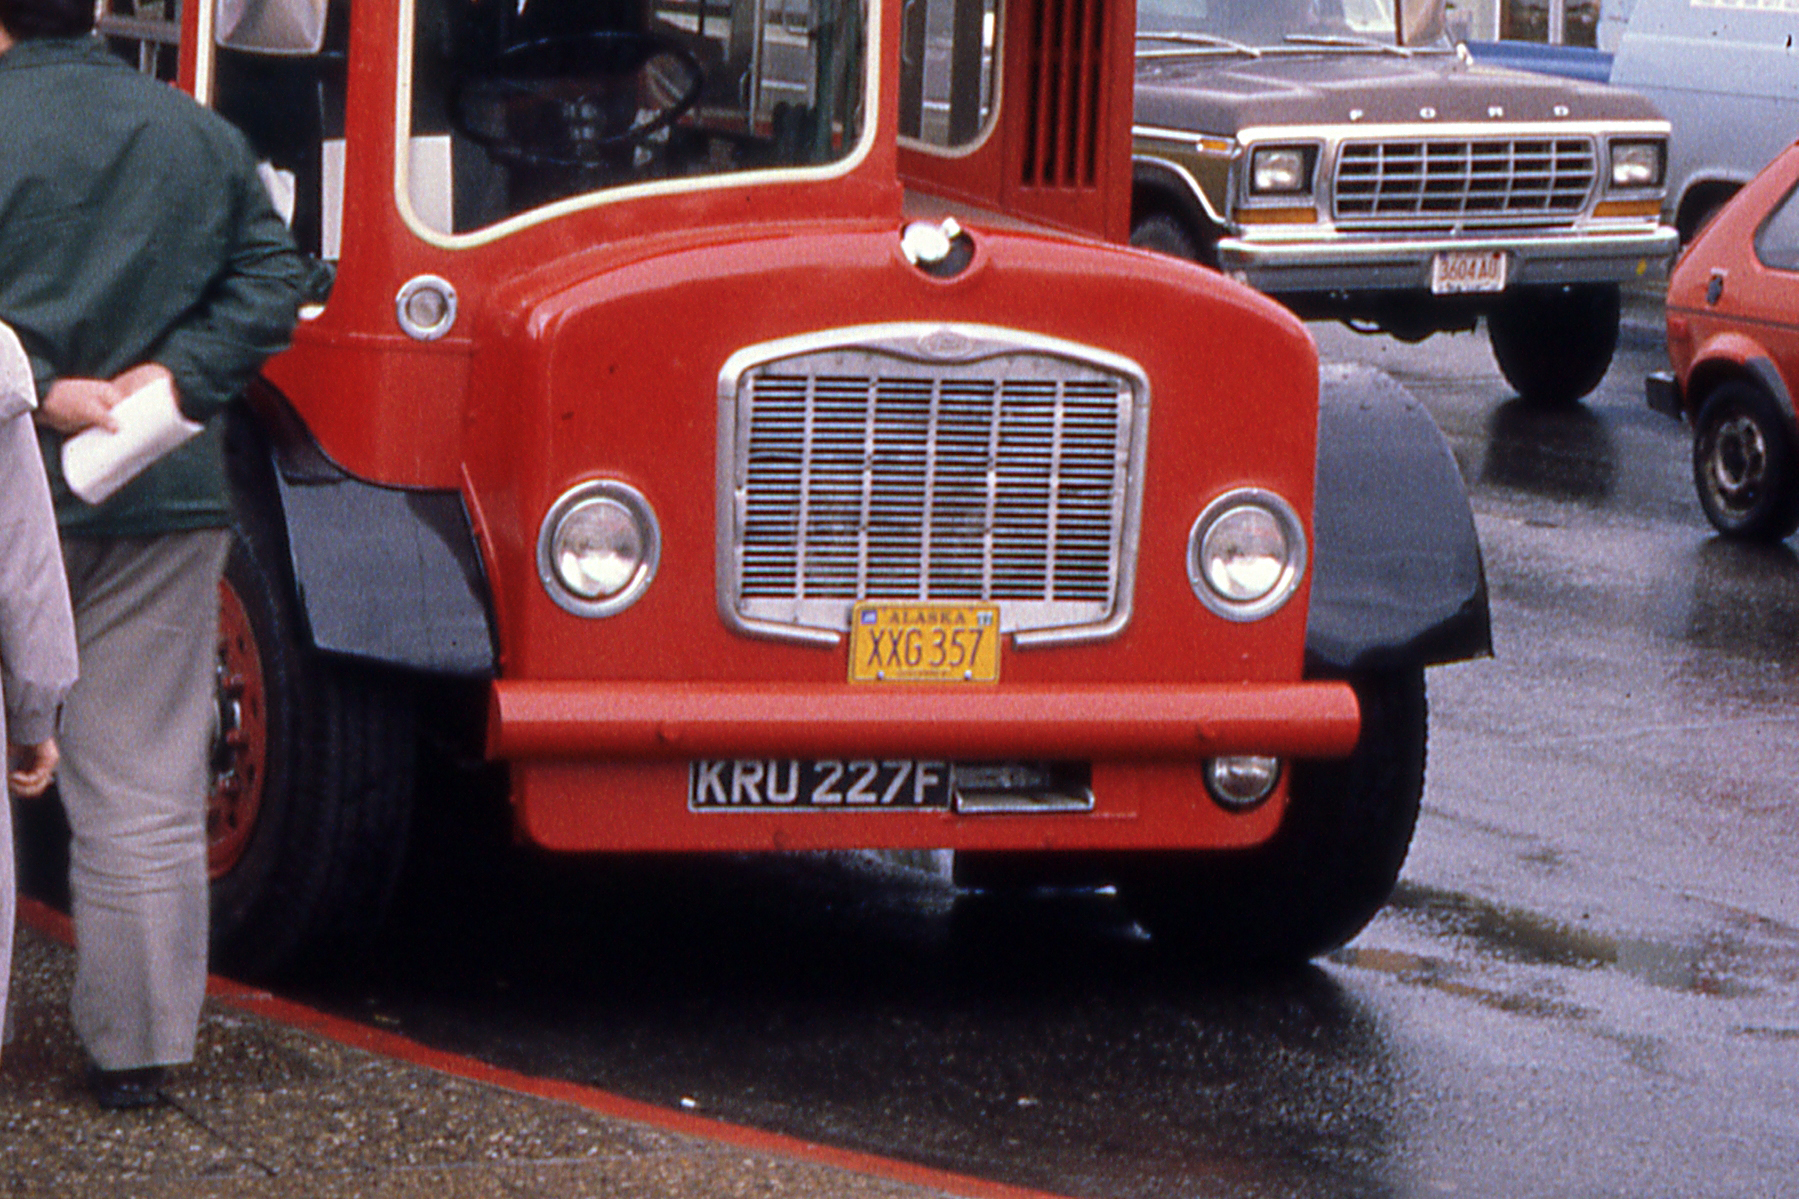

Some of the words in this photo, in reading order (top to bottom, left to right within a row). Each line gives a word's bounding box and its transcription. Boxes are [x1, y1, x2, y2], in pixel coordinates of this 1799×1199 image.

[1349, 104, 1570, 121] FORD
[890, 611, 965, 625] ALASKA
[867, 627, 923, 667] XXG
[928, 627, 985, 667] 357
[696, 759, 799, 804] KRU
[810, 760, 946, 804] 227F
